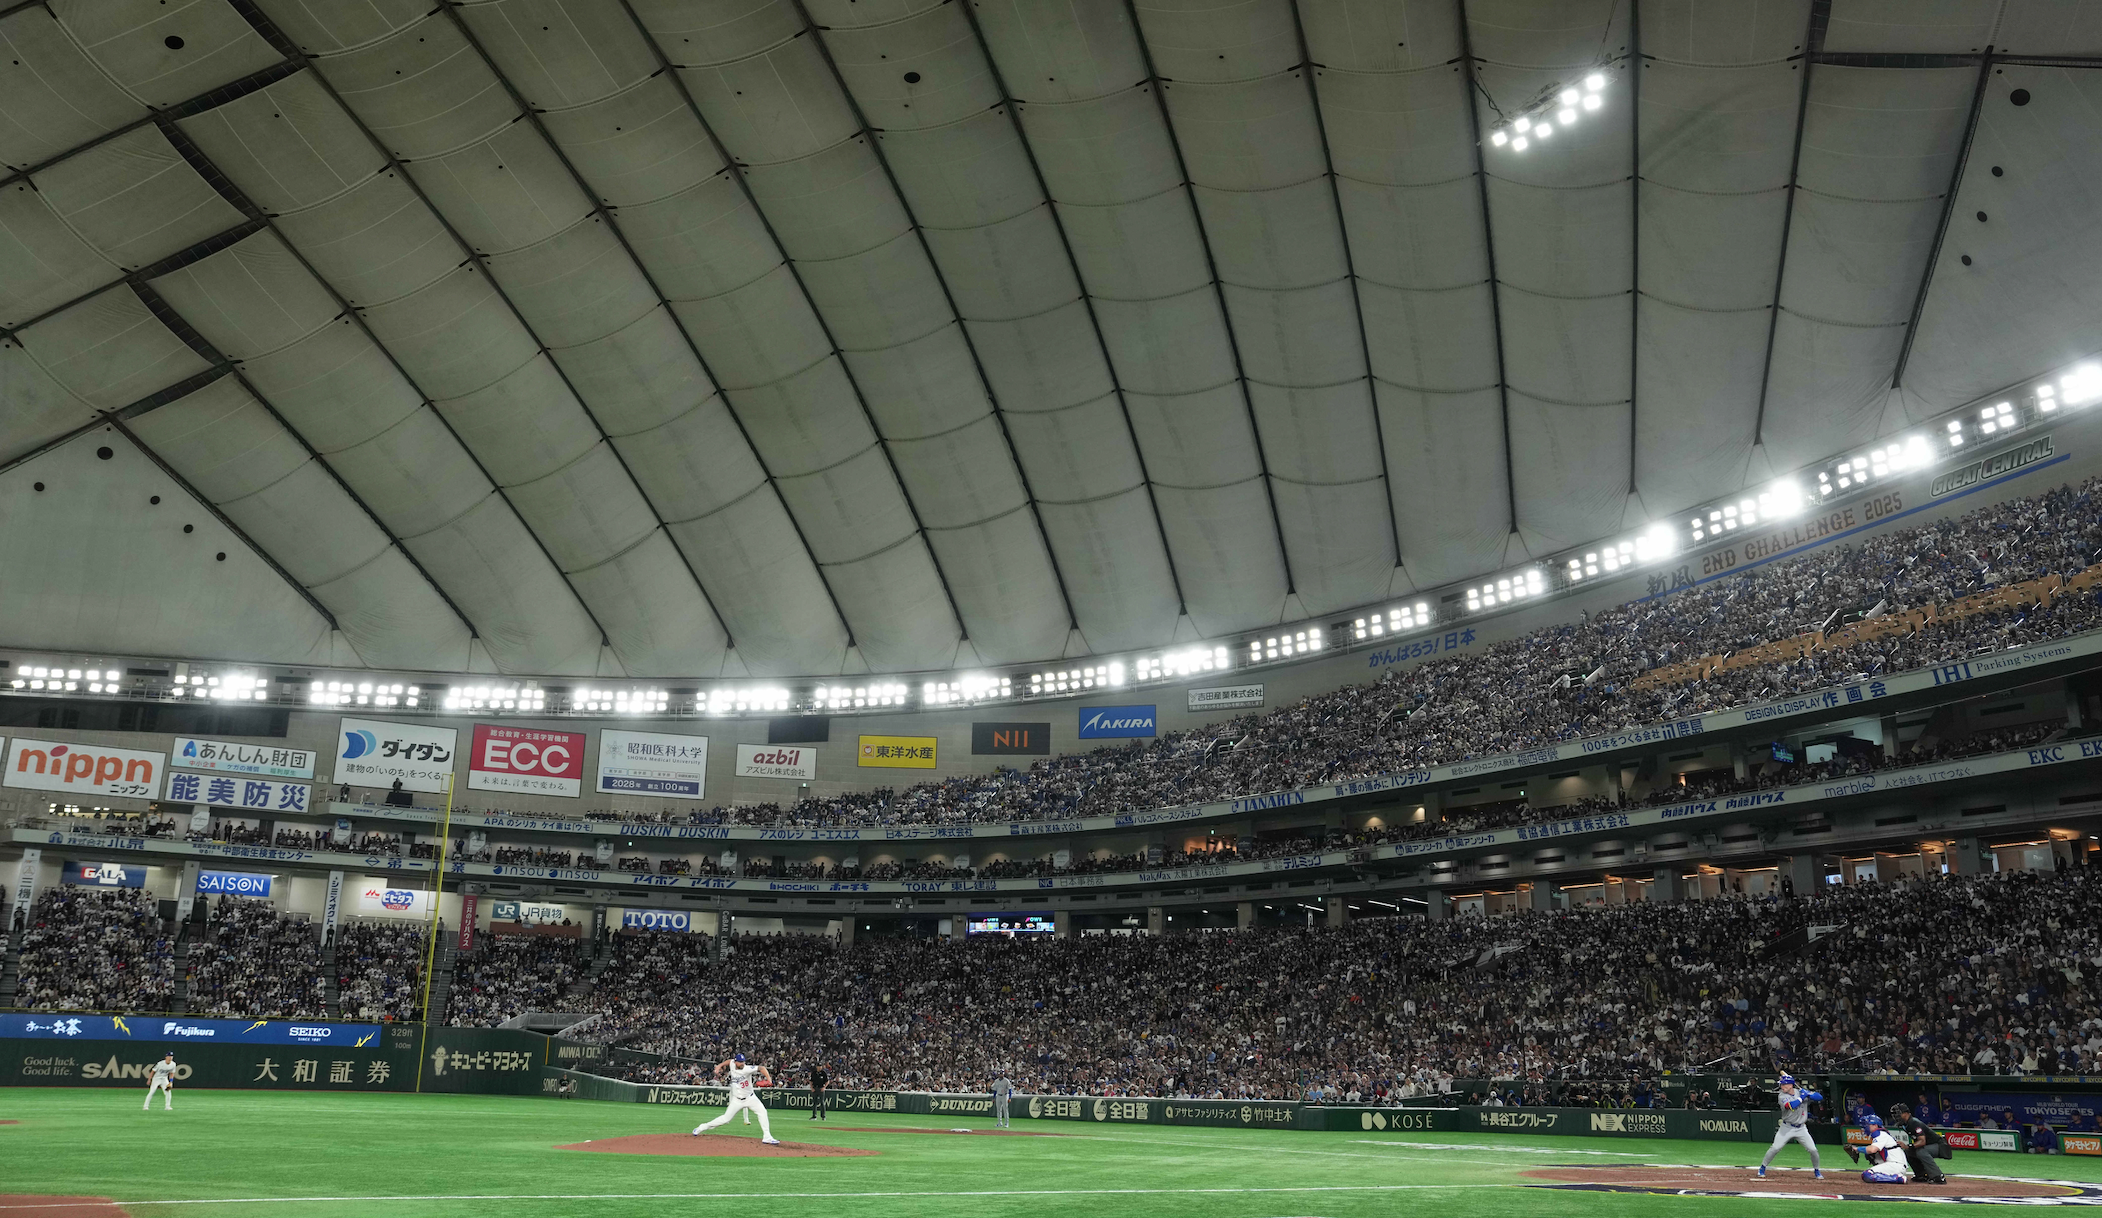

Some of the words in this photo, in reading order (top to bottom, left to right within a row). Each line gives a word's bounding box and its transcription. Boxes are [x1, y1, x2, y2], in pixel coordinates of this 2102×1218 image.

[1932, 460, 1982, 496] GREAT
[1980, 435, 2054, 480] CENTRAL
[1702, 548, 1737, 576] 2ND
[1744, 508, 1857, 561] CHALLENGE
[1863, 490, 1903, 522] 2025
[1444, 628, 1477, 651] 日本
[1931, 662, 1974, 686] IHI
[1976, 655, 2022, 673] Parking
[2023, 645, 2072, 662] Systems
[1745, 707, 1777, 721] DESIGN
[1784, 697, 1822, 713] DISPLAY
[1822, 681, 1888, 708] 作画会
[1099, 718, 1154, 729] AKIRA
[490, 729, 569, 744] 総合教育・生涯学習機関
[1581, 729, 1661, 753] 100年をつくる会社
[200, 743, 307, 769] あんしん財団
[381, 739, 451, 763] ダイダン
[484, 739, 570, 774] ECC
[627, 742, 702, 759] 昭和医科大学
[753, 749, 801, 766] azbil
[876, 746, 934, 760] 東洋水産
[2027, 746, 2065, 765] EKC
[17, 745, 154, 786] nippn
[672, 758, 701, 766] University
[346, 763, 442, 781] 建物の「いのち」をつくる
[746, 765, 807, 778] アズビル株式会社
[1391, 771, 1431, 787] バンテリン
[109, 784, 149, 796] ニップン
[482, 776, 568, 791] 未来は、言葉で変わる。
[611, 779, 642, 789] 2028年
[1824, 780, 1870, 798] marble
[171, 774, 306, 812] 能美防災
[1244, 791, 1304, 811] TANAKEN
[484, 817, 505, 827] APA
[811, 830, 860, 840] ユーエスエス
[222, 847, 313, 860] 中部衛生検査センター
[198, 874, 265, 892] SAISON
[497, 904, 516, 915] JR
[521, 907, 562, 919] JR貨物
[462, 899, 475, 947] 三井のリハウス
[626, 911, 688, 930] TOTO
[174, 1026, 216, 1037] Fujikura
[289, 1027, 332, 1038] SEIKO
[391, 1028, 413, 1038] 329ft
[558, 1046, 581, 1059] MIWA
[24, 1056, 52, 1066] Good
[54, 1057, 79, 1067] luck.
[81, 1055, 193, 1080] SANKO
[451, 1051, 533, 1072] キューピーマヨネーズ
[22, 1066, 51, 1076] Good
[52, 1067, 73, 1077] life.
[253, 1058, 391, 1084] 大和証券
[740, 1080, 749, 1089] 38
[784, 1092, 832, 1108] Tombw
[836, 1094, 897, 1111] トンボ鉛筆
[939, 1099, 994, 1112] DUNLOP
[1043, 1100, 1082, 1118] 全日警
[1109, 1101, 1149, 1120] 全日警
[1253, 1107, 1293, 1123] 竹中土木
[2023, 1106, 2058, 1115] TOKYO
[1392, 1112, 1433, 1129] KOSÉ
[1489, 1112, 1559, 1128] 長谷工グループ
[1627, 1114, 1666, 1125] NIPPON
[1700, 1119, 1749, 1133] NOMURA
[1627, 1123, 1667, 1133] EXPRESS
[2064, 1139, 2100, 1151] タケモトピアノ
